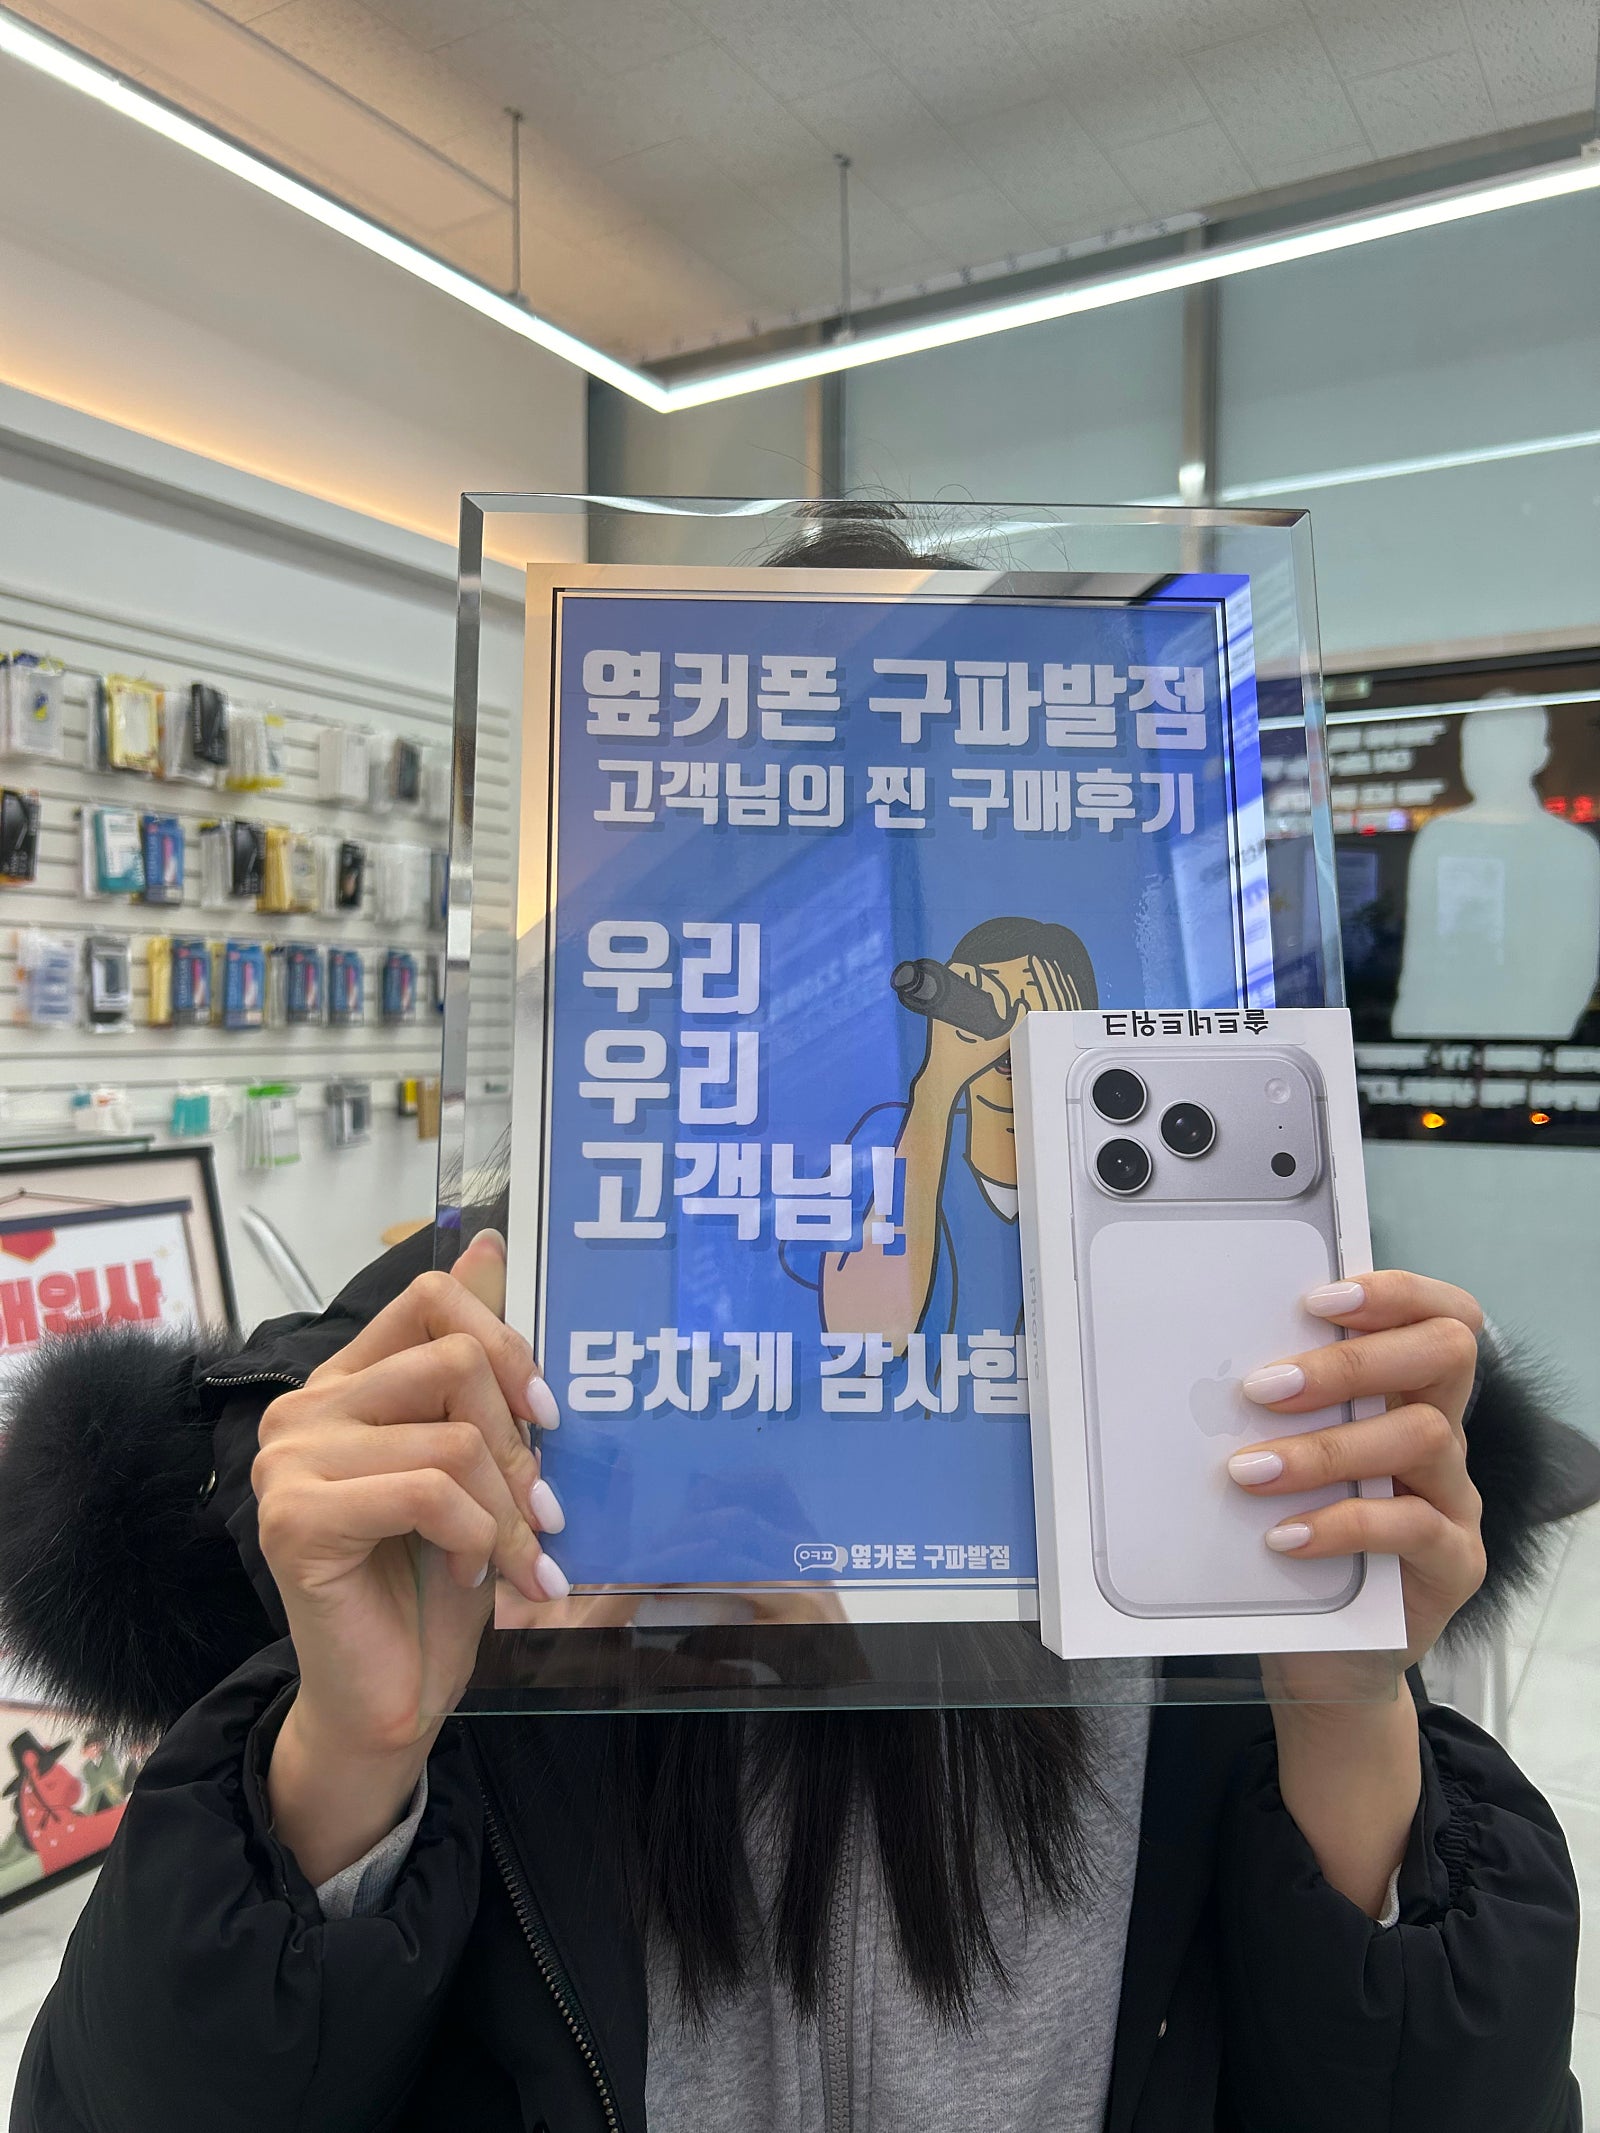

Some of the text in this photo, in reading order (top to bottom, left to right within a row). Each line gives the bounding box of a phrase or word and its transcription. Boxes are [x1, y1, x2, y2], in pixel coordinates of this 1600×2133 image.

[582, 649, 1207, 750] 옆커폰 구파발점
[593, 759, 1195, 834] 고객님의 찐 구매후기
[583, 920, 761, 1015] 우리
[1102, 1009, 1269, 1038] 솔트네트워크
[578, 1030, 759, 1126] 우리
[573, 1141, 896, 1245] 고객님!
[567, 1329, 792, 1413] 당차게
[851, 1544, 916, 1570] 옆커폰
[922, 1544, 1010, 1570] 구파발점
